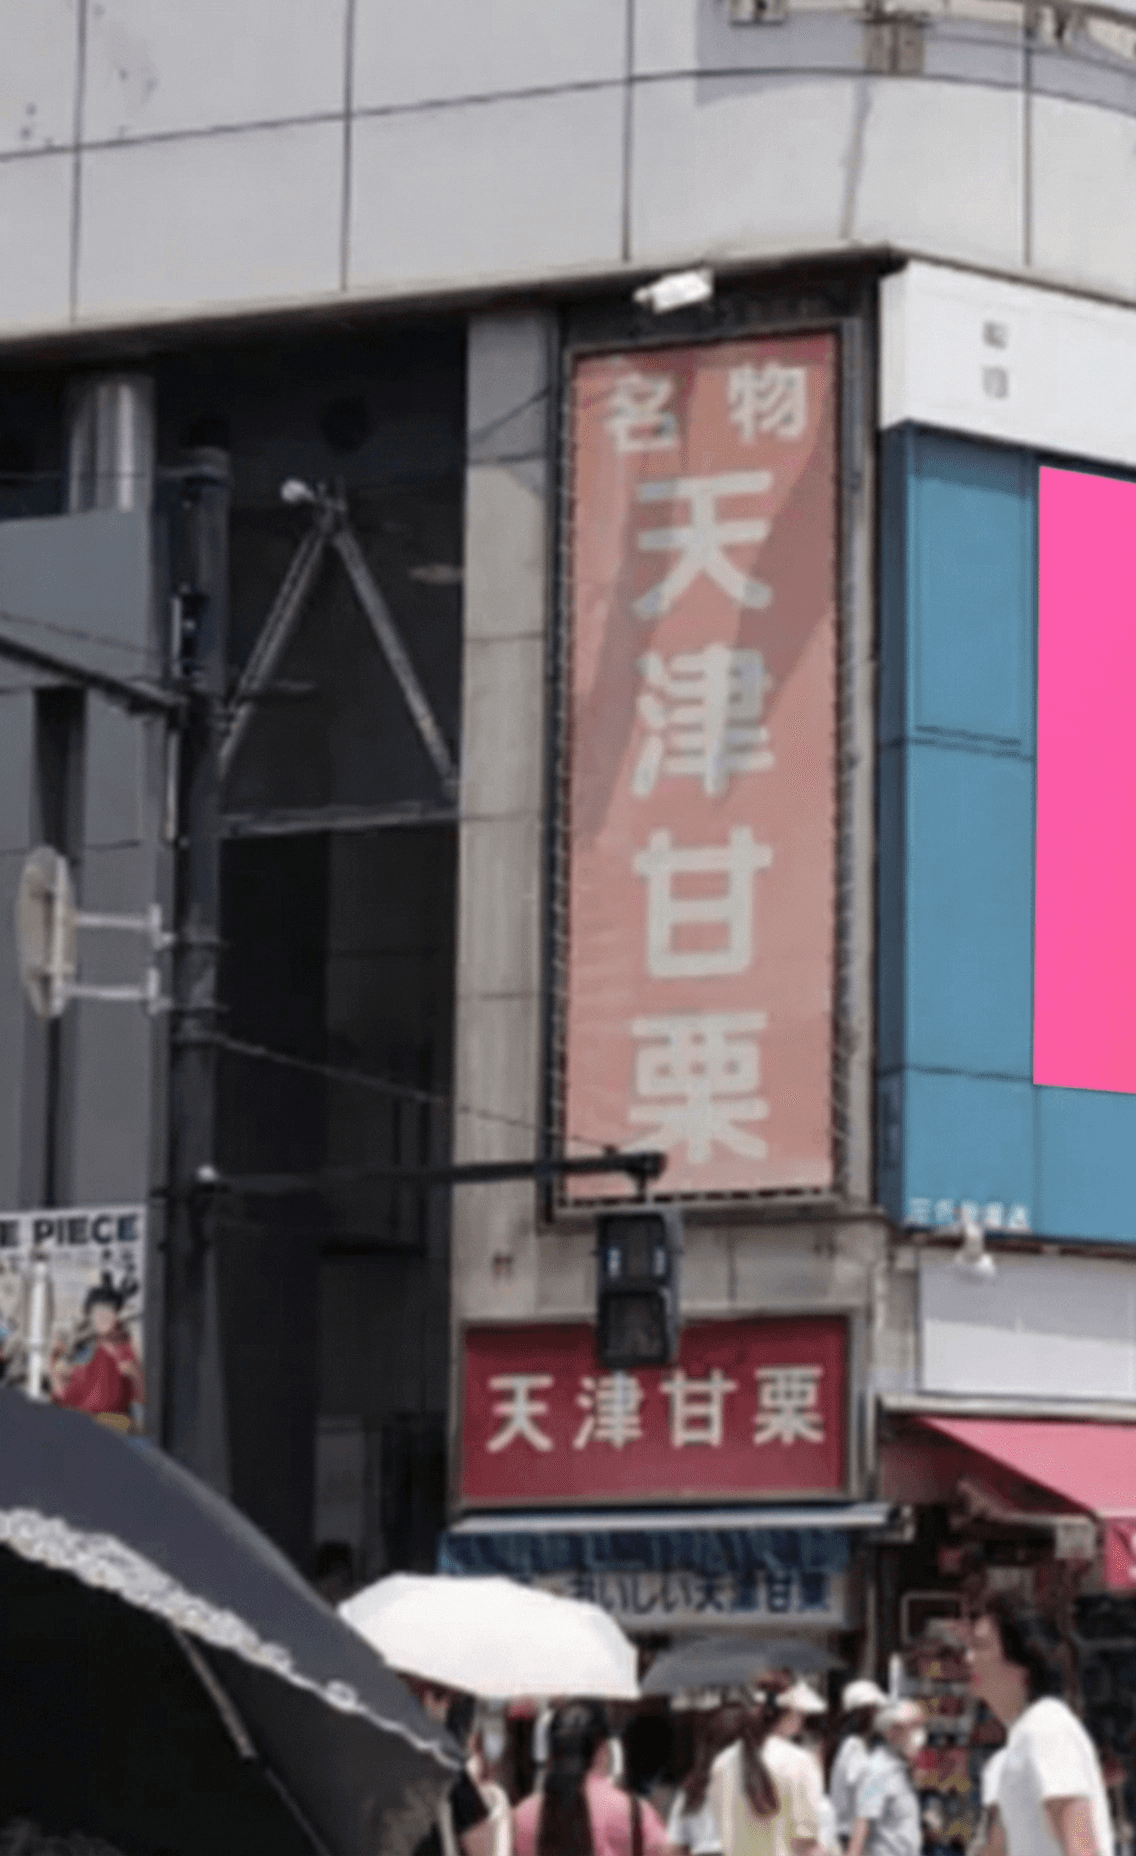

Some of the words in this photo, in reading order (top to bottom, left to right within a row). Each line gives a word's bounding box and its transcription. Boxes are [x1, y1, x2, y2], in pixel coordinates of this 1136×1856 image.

[607, 362, 808, 454] 名物
[629, 470, 776, 1164] 天津甘栗
[33, 1212, 138, 1246] PIECE
[485, 1364, 825, 1453] 天津甘栗
